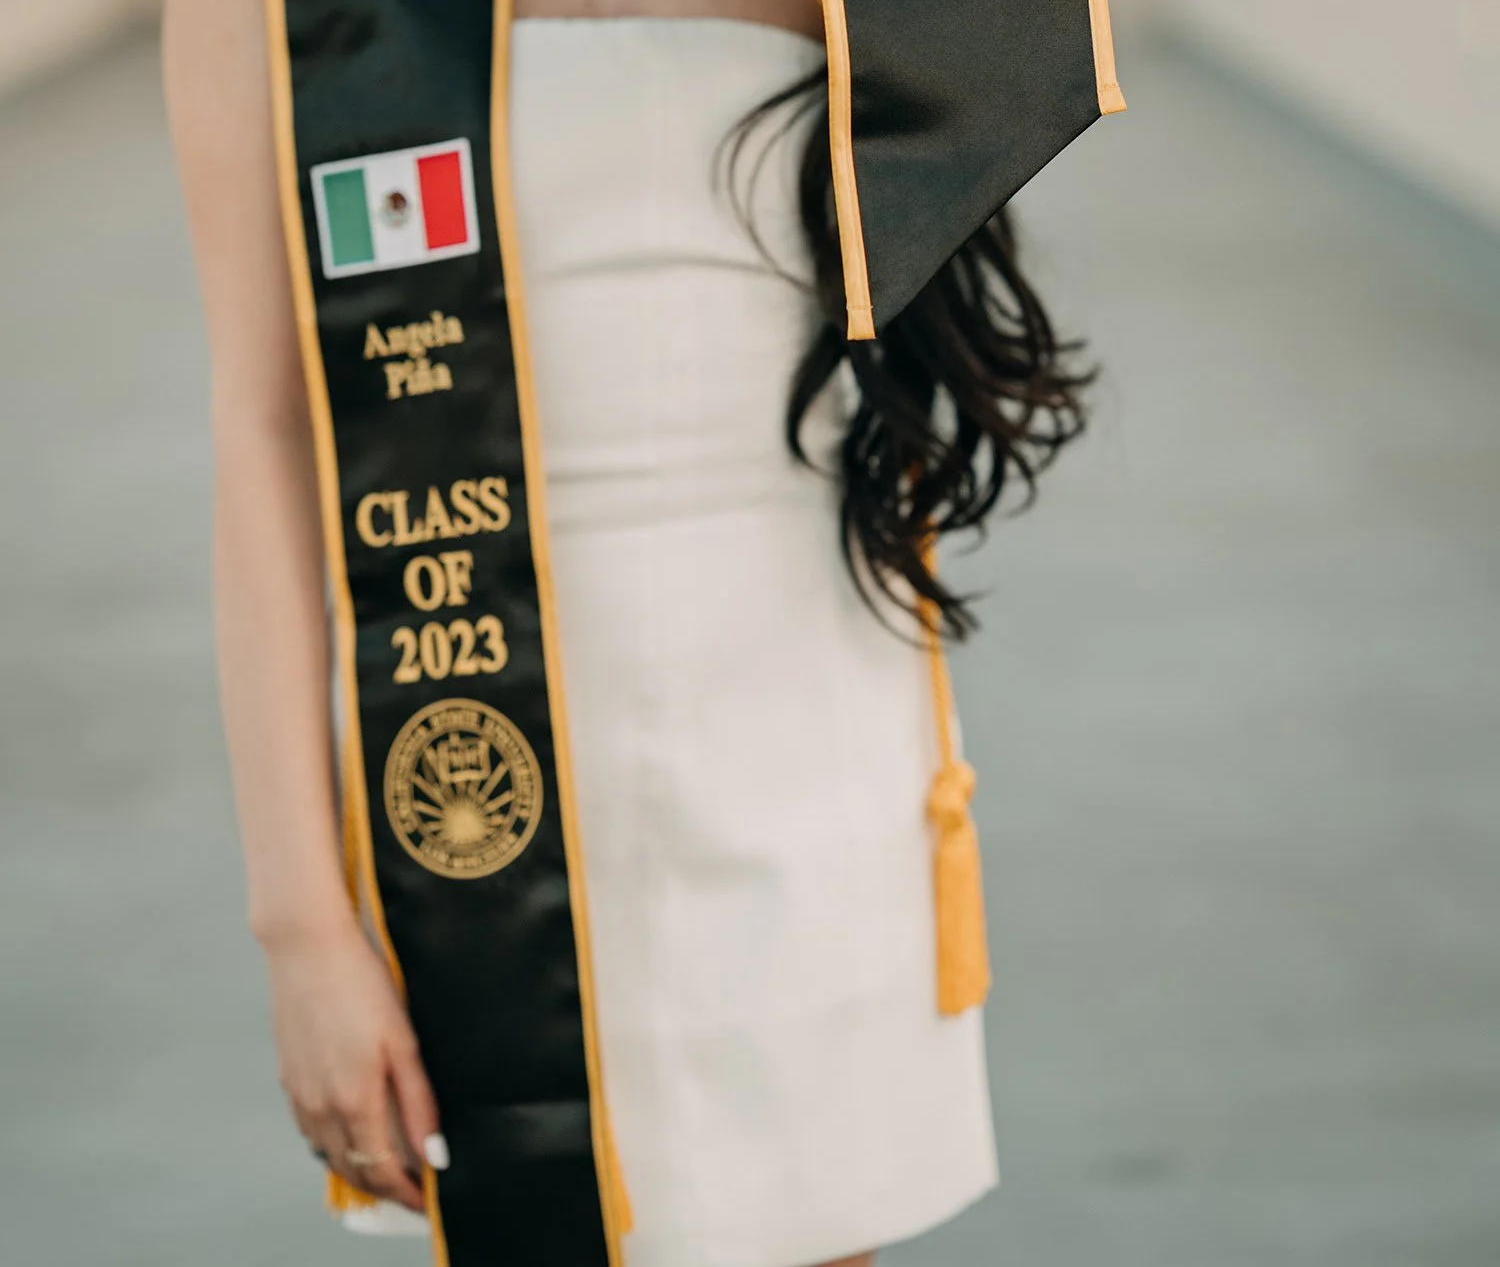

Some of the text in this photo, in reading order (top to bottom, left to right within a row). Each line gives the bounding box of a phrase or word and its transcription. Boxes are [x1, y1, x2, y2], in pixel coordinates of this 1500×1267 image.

[364, 310, 465, 360] Angela
[355, 476, 512, 548] CLASS
[403, 550, 474, 612] OF
[391, 614, 509, 684] 2023
